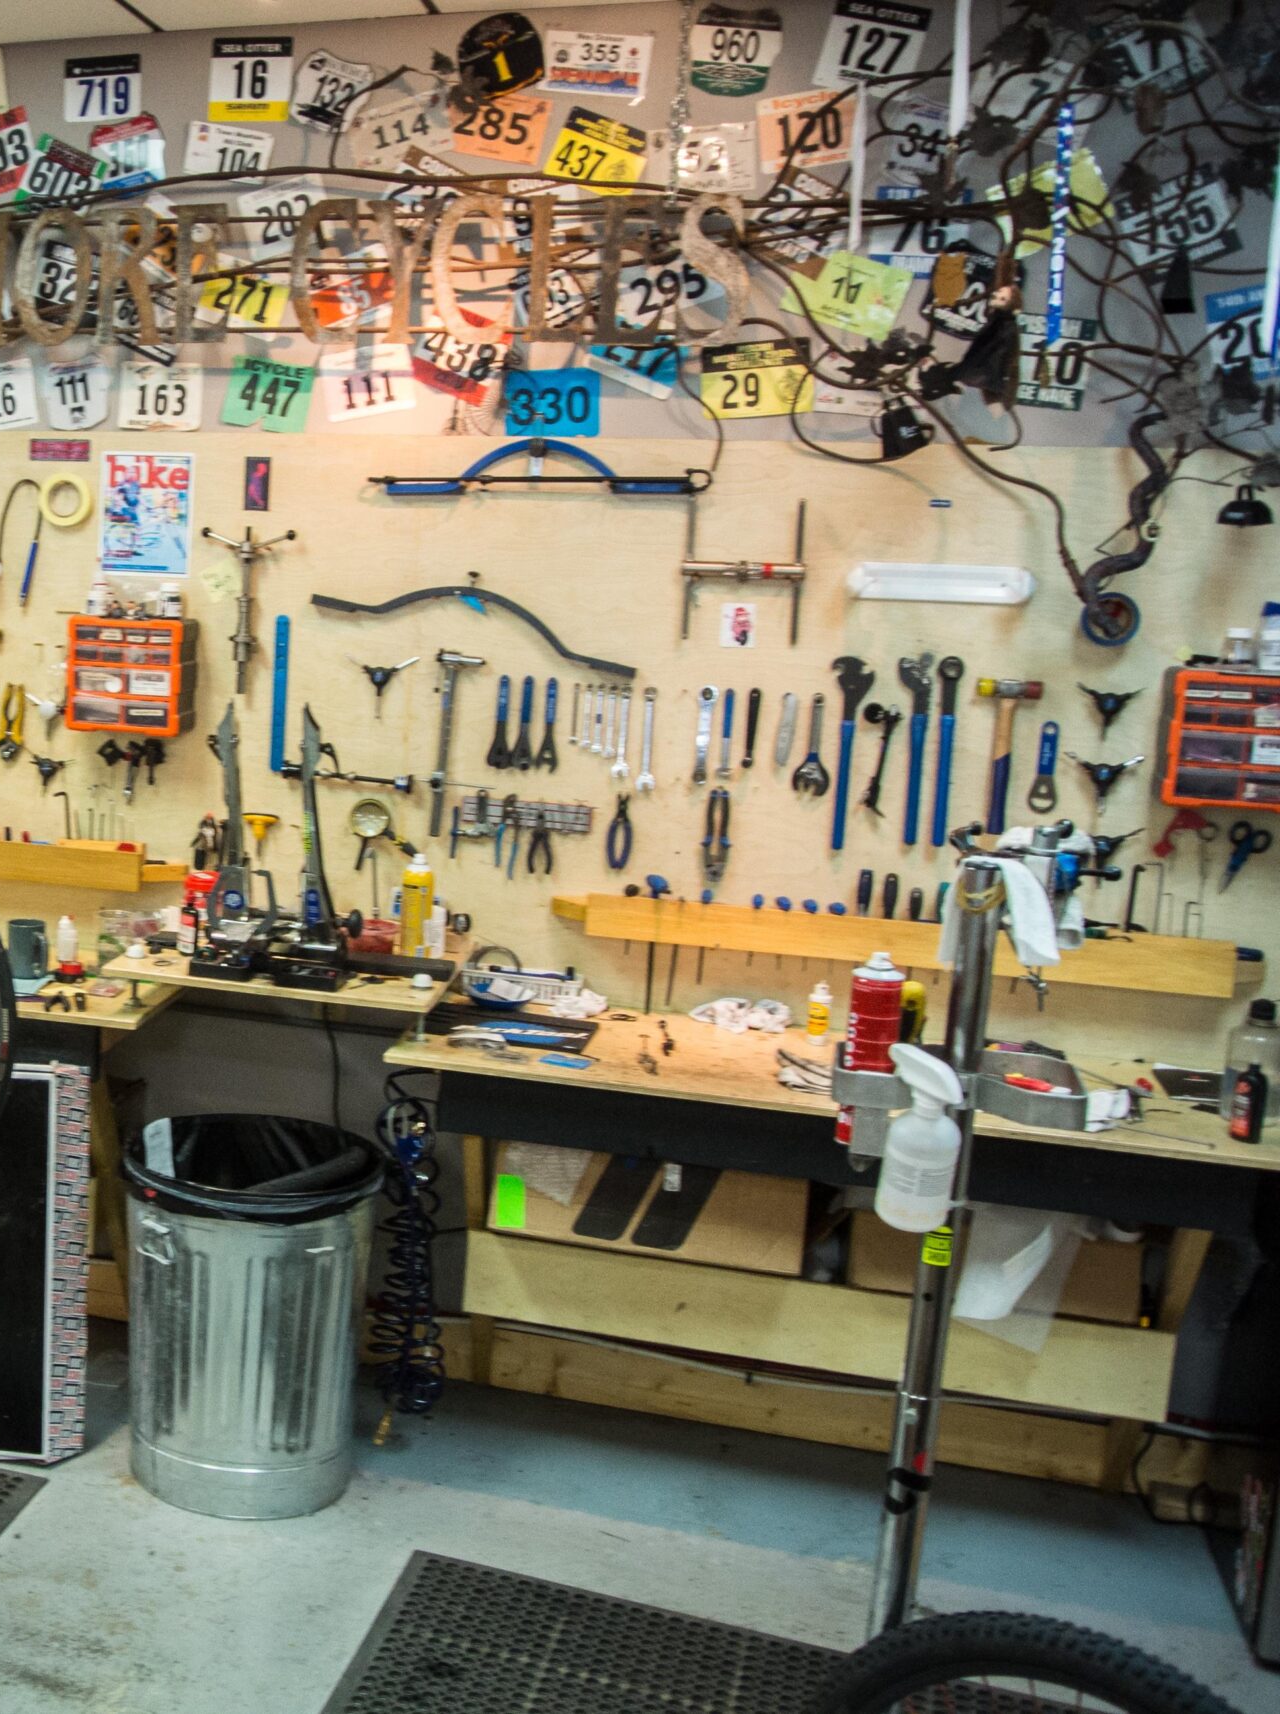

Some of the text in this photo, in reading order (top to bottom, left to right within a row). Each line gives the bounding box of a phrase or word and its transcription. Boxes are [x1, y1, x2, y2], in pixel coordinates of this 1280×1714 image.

[581, 42, 621, 63] 355
[711, 29, 760, 63] 960
[839, 24, 911, 74] 127
[234, 60, 266, 99] 16
[493, 51, 511, 82] 1
[78, 76, 130, 117] 719
[313, 74, 355, 113] 132
[375, 113, 430, 149] 114
[454, 108, 531, 145] 285
[778, 106, 842, 156] 120
[555, 140, 608, 180] 437
[288, 194, 749, 347] CYCLES
[630, 262, 706, 316] 295
[215, 276, 274, 324] 271
[244, 359, 306, 380] ICYCLE
[422, 332, 497, 381] 438
[56, 372, 90, 405] 111
[138, 384, 187, 416] 163
[240, 372, 300, 417] 447
[342, 372, 395, 410] 111
[511, 386, 591, 426] 330
[721, 373, 759, 409] 29
[107, 456, 190, 490] bike
